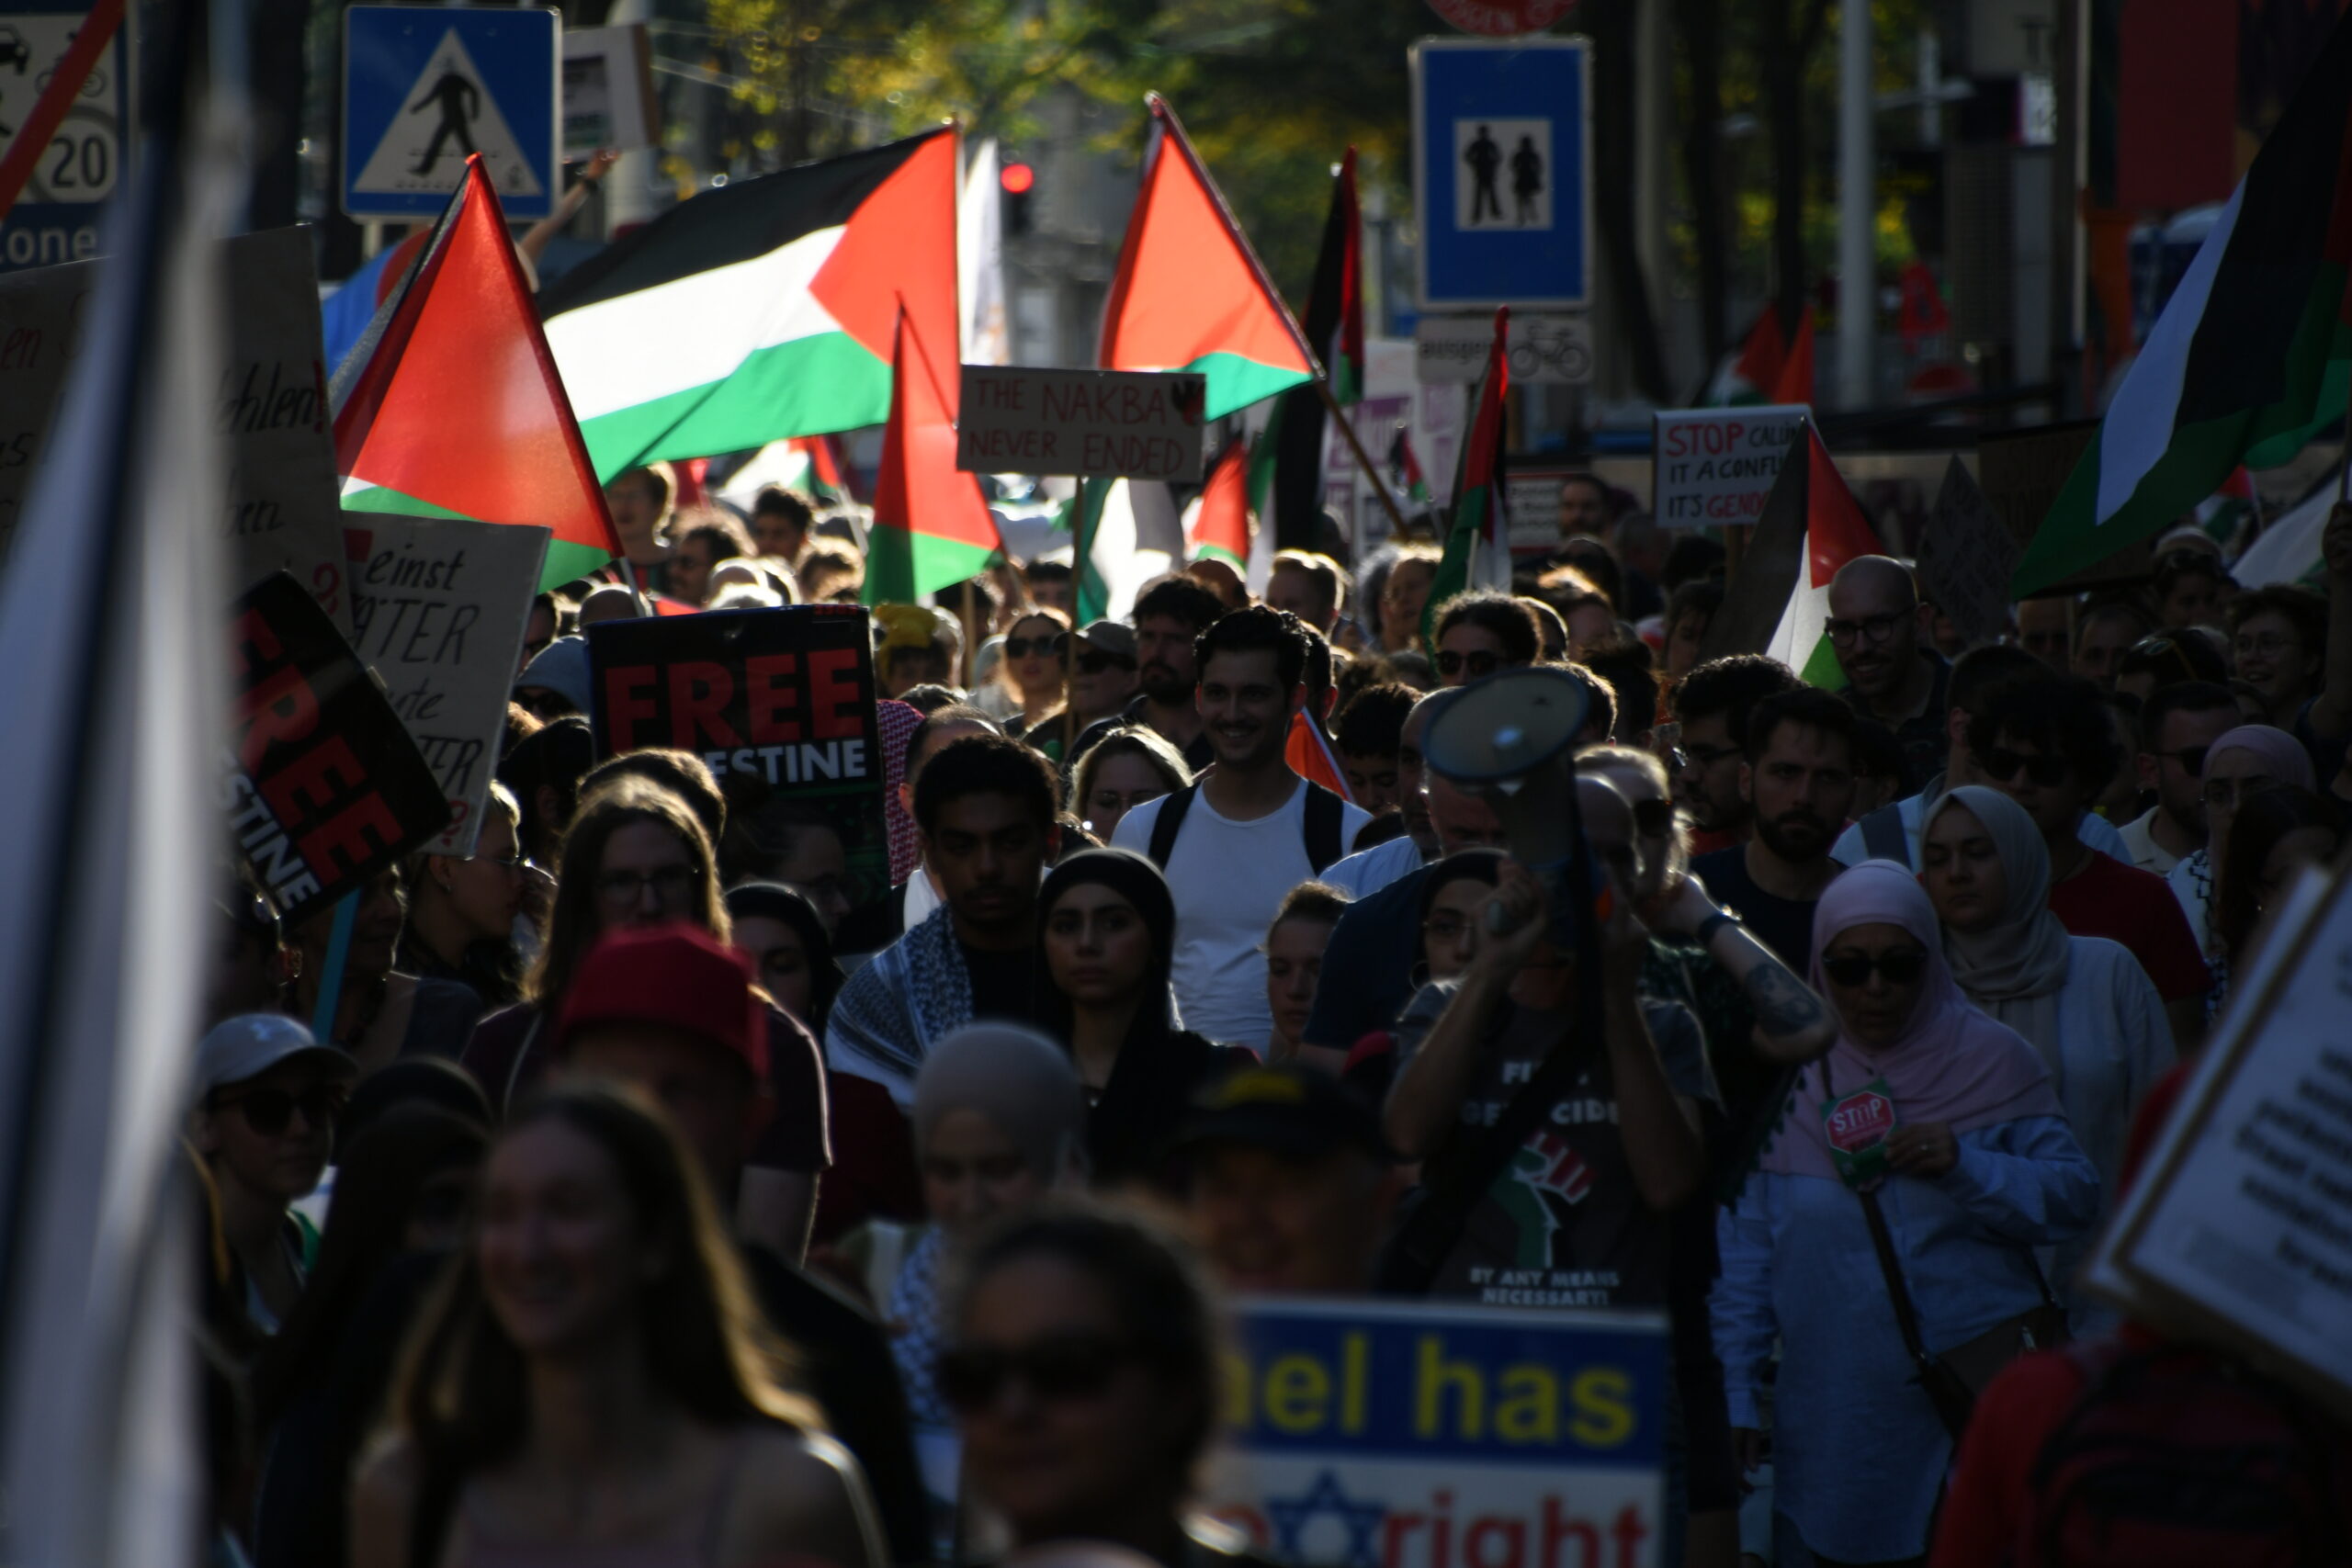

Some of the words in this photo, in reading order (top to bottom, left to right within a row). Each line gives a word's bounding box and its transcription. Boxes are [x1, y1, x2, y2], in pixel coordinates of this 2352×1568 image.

[51, 137, 107, 188] 20
[0, 225, 98, 265] one
[977, 378, 1027, 411] THE
[1041, 382, 1166, 426] NAKBA
[967, 427, 1058, 458] NEVER
[1082, 433, 1185, 476] ENDED
[1666, 422, 1745, 457] STOP
[1670, 463, 1690, 483] IT
[1697, 461, 1714, 480] A
[366, 544, 464, 592] einst
[605, 648, 864, 756] FREE
[1481, 1287, 1611, 1306] NECESSARY!
[1498, 1269, 1544, 1286] ANY
[1550, 1270, 1621, 1288] MEANS
[1413, 1333, 1640, 1449] has
[1381, 1490, 1651, 1568] right
